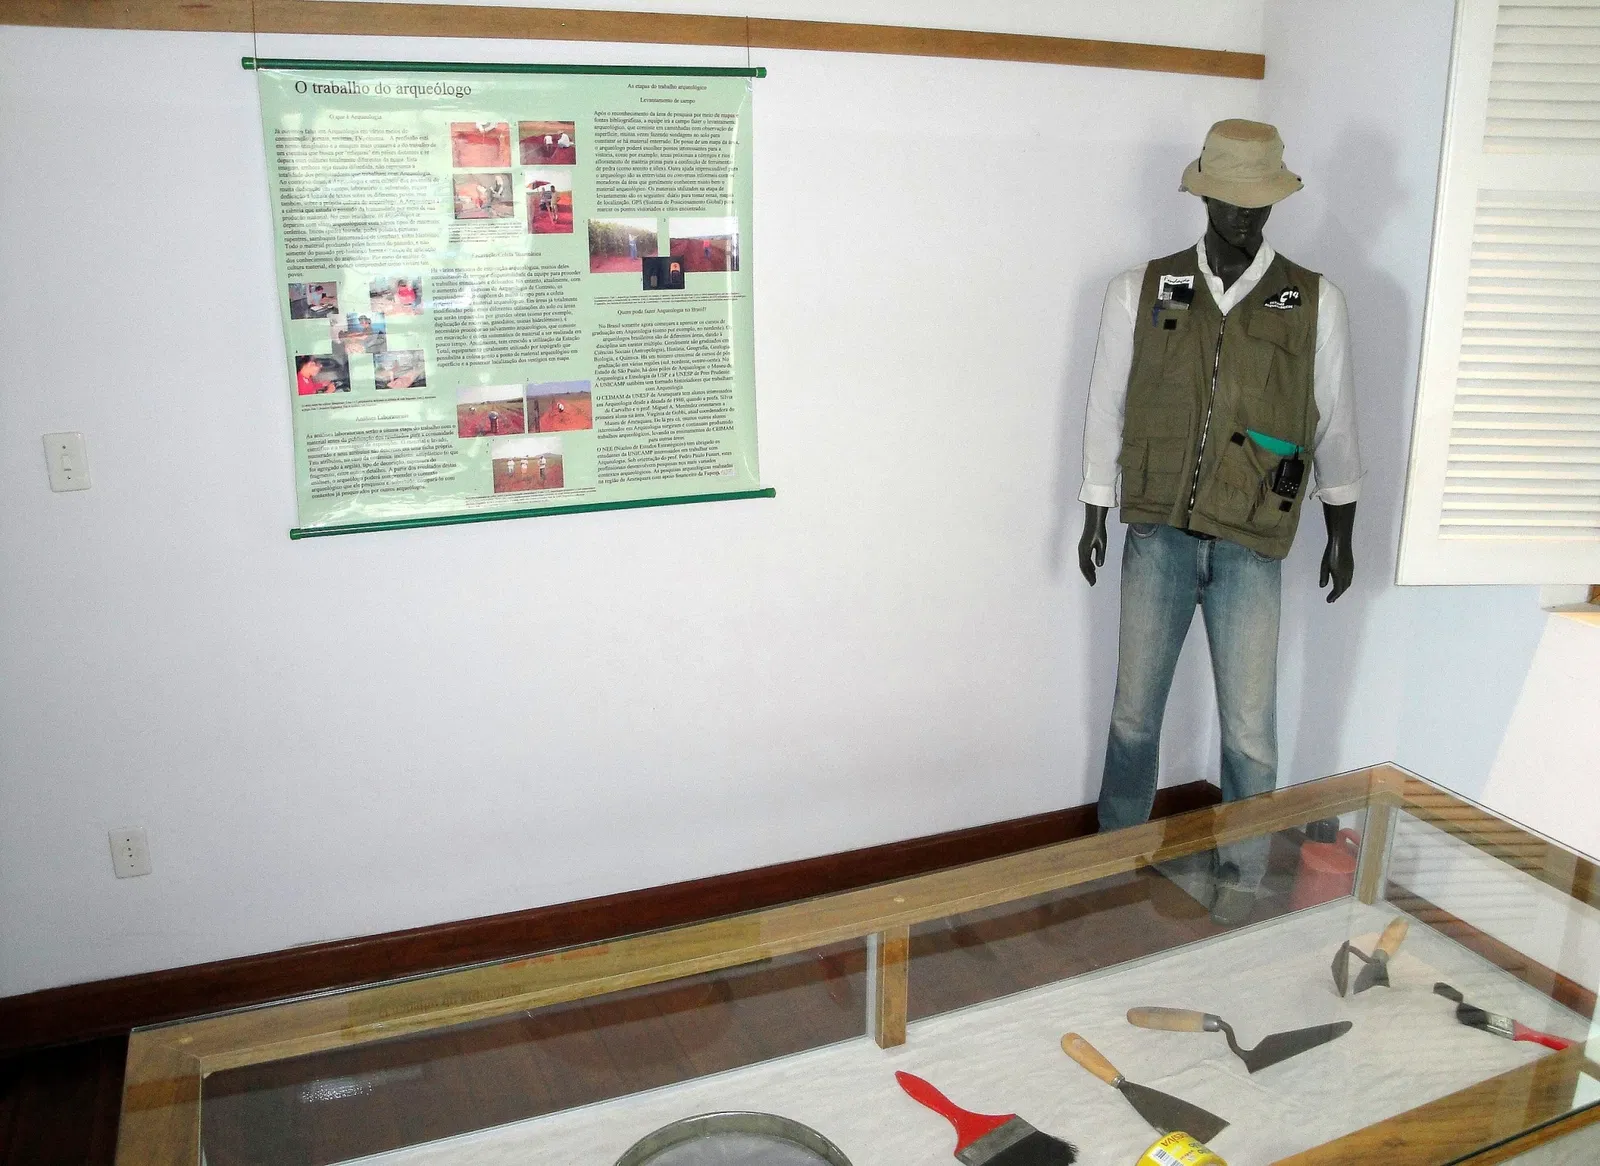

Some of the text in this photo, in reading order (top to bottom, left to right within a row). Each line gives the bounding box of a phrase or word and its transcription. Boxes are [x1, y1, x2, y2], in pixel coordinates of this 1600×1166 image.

[295, 81, 471, 98] O trabalho do arqueólogo
